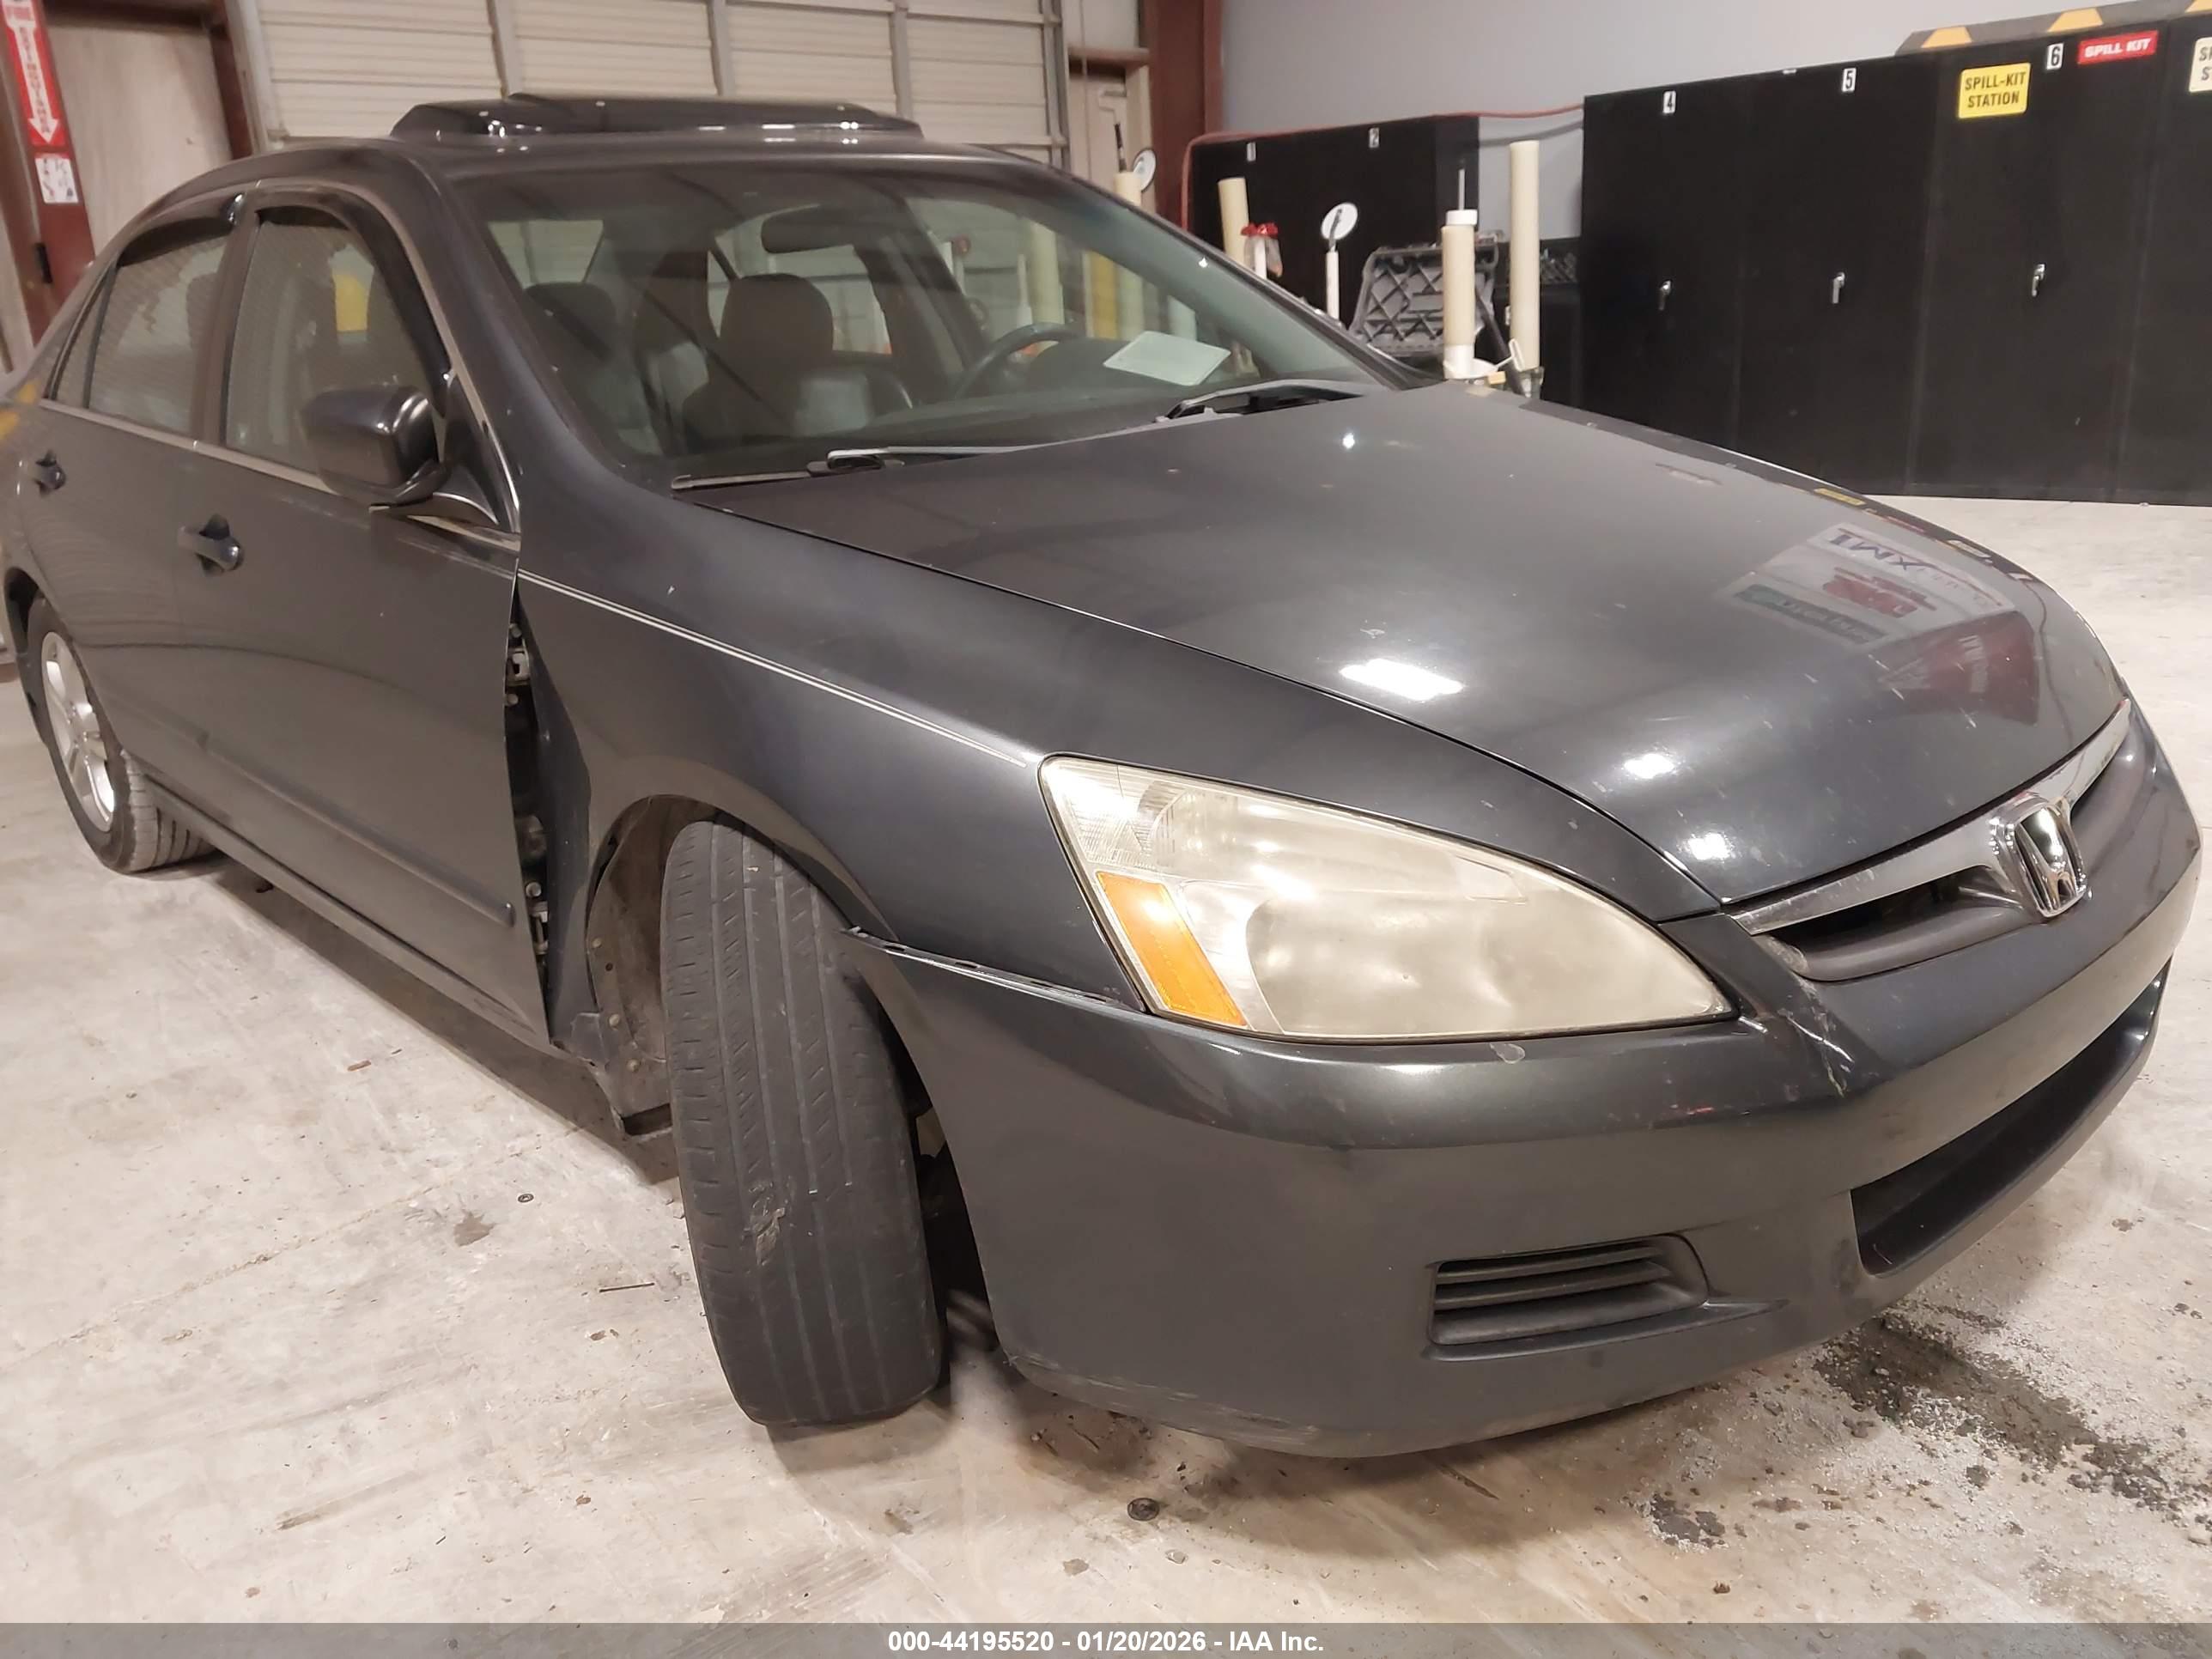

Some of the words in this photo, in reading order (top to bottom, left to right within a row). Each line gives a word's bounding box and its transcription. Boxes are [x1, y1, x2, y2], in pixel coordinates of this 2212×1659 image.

[2051, 46, 2060, 66] 6
[2084, 42, 2124, 58] SPILL
[2126, 38, 2151, 52] KIT
[1845, 70, 1855, 89] 5
[1965, 71, 2026, 90] SPILL-KIT
[1967, 90, 2020, 108] STATION
